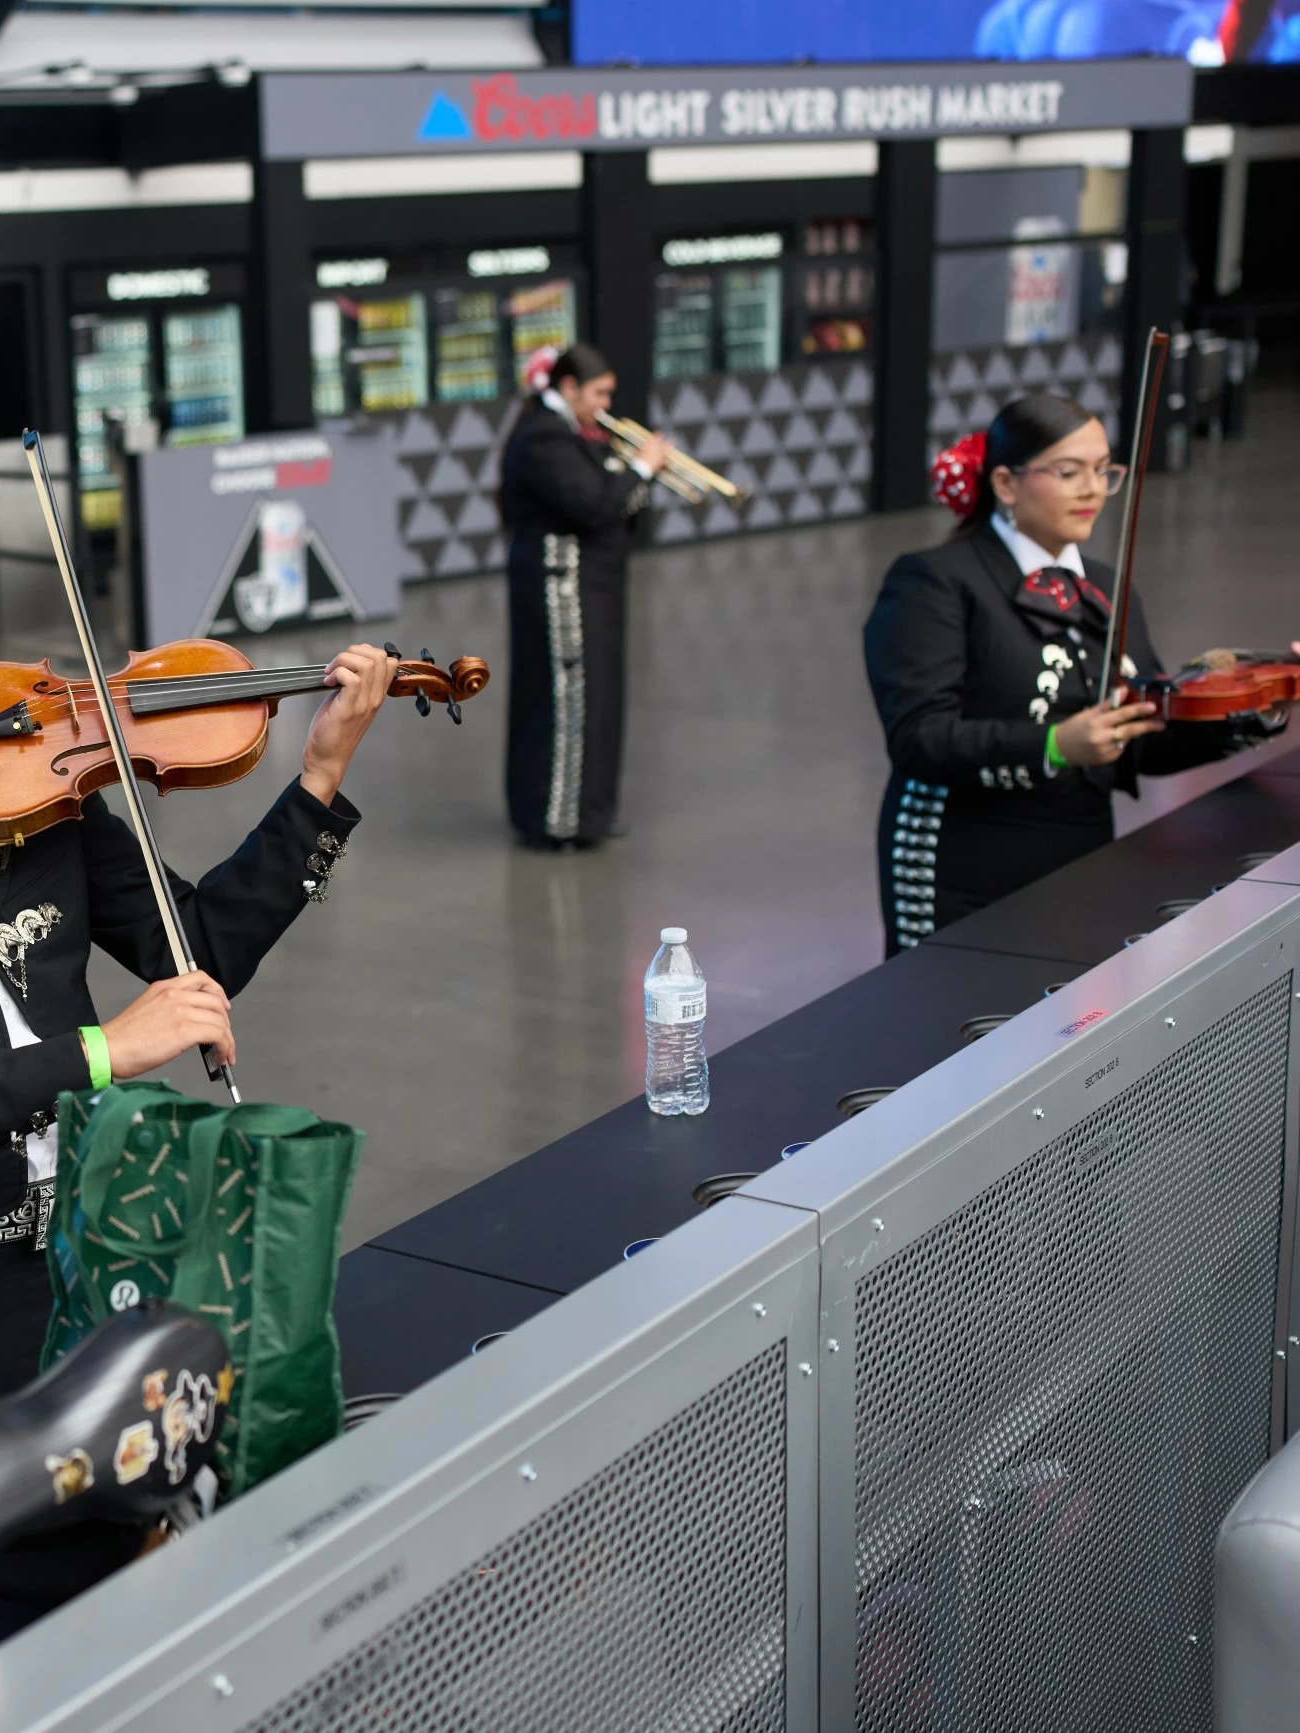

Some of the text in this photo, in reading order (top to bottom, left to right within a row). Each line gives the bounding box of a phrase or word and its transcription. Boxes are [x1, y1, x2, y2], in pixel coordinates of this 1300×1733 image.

[600, 89, 711, 139] LIGHT
[720, 87, 838, 136] SILVER
[841, 83, 934, 131] RUSH
[936, 79, 1064, 127] MARKET
[107, 267, 210, 300] DOMESTIC
[316, 258, 388, 287] IMPORT
[1060, 1020, 1089, 1035] SECTION
[1084, 1066, 1106, 1089] SECTION
[1106, 1060, 1115, 1074] 202
[1079, 1145, 1100, 1166] SECTION
